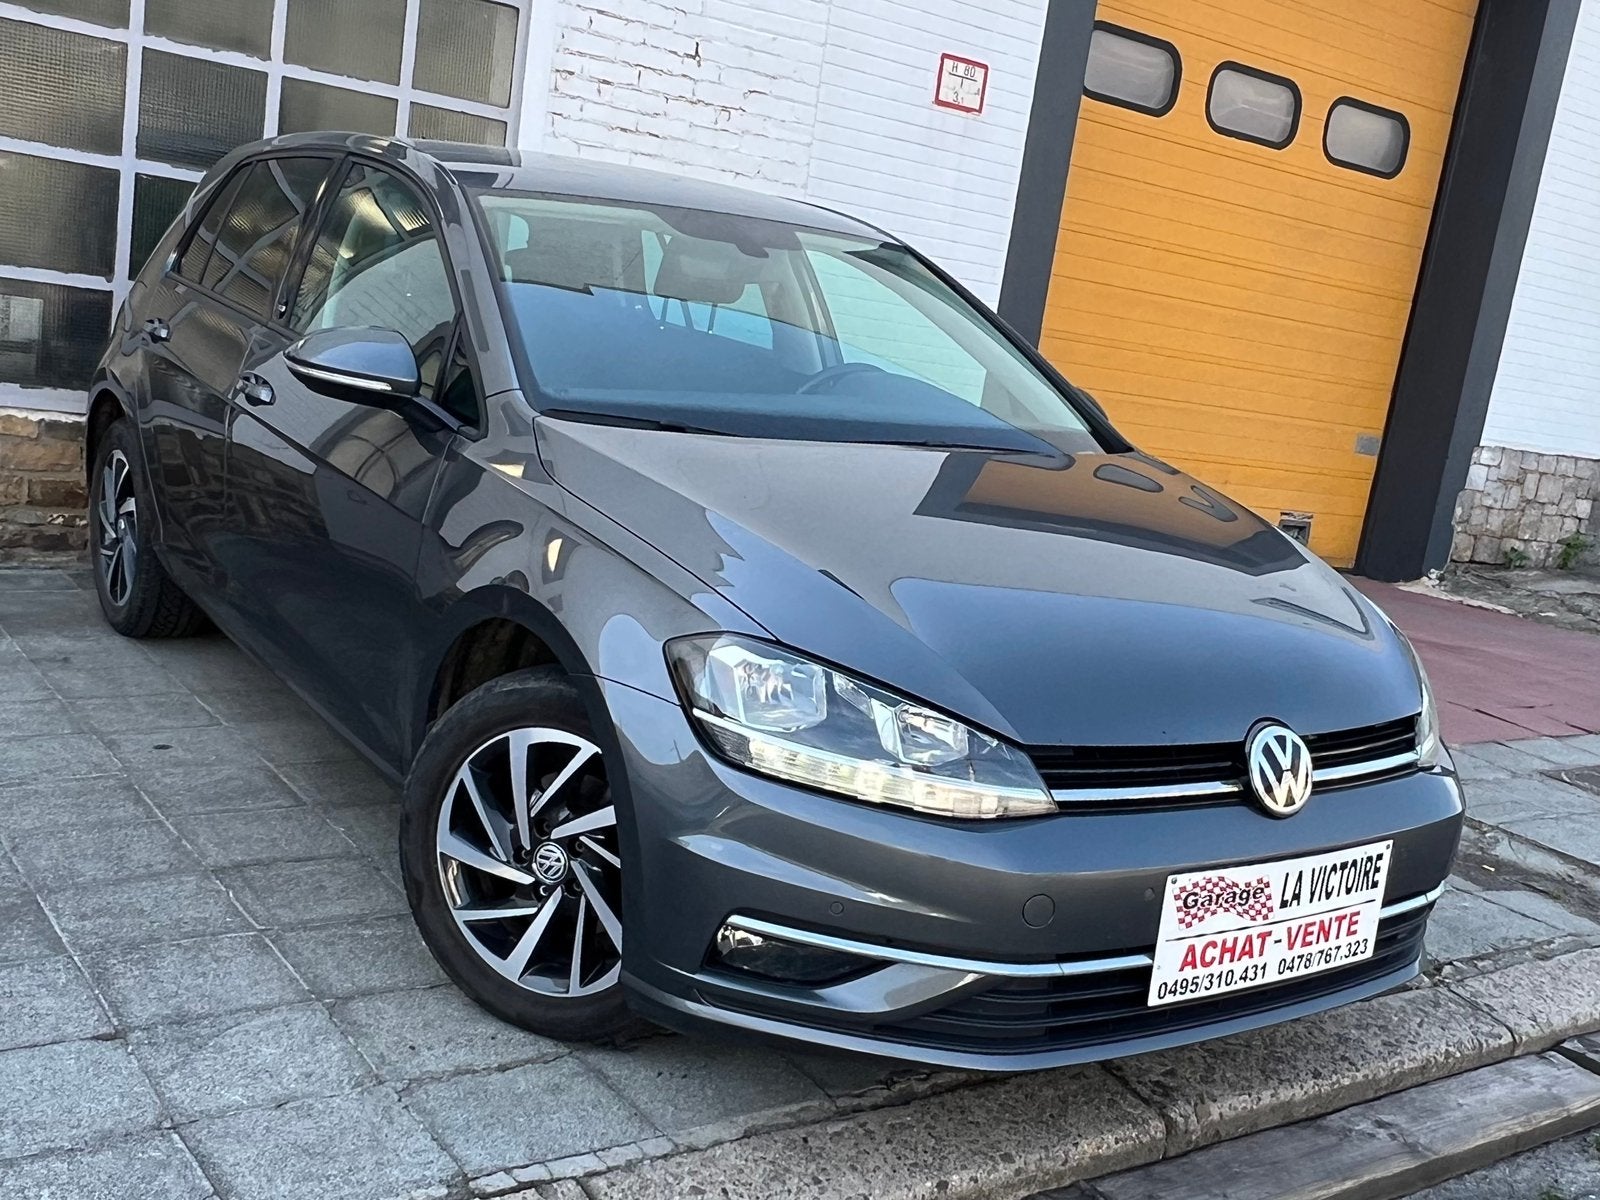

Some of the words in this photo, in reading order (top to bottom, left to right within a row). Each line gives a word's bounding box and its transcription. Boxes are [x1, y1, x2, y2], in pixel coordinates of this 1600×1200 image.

[952, 61, 959, 73] H
[963, 65, 977, 79] 80
[1182, 886, 1265, 910] Garage
[1279, 869, 1303, 909] LA
[1309, 853, 1384, 904] VICTOIRE
[1157, 961, 1268, 1000] 0495/310.431
[1277, 938, 1369, 976] 0478/767.323
